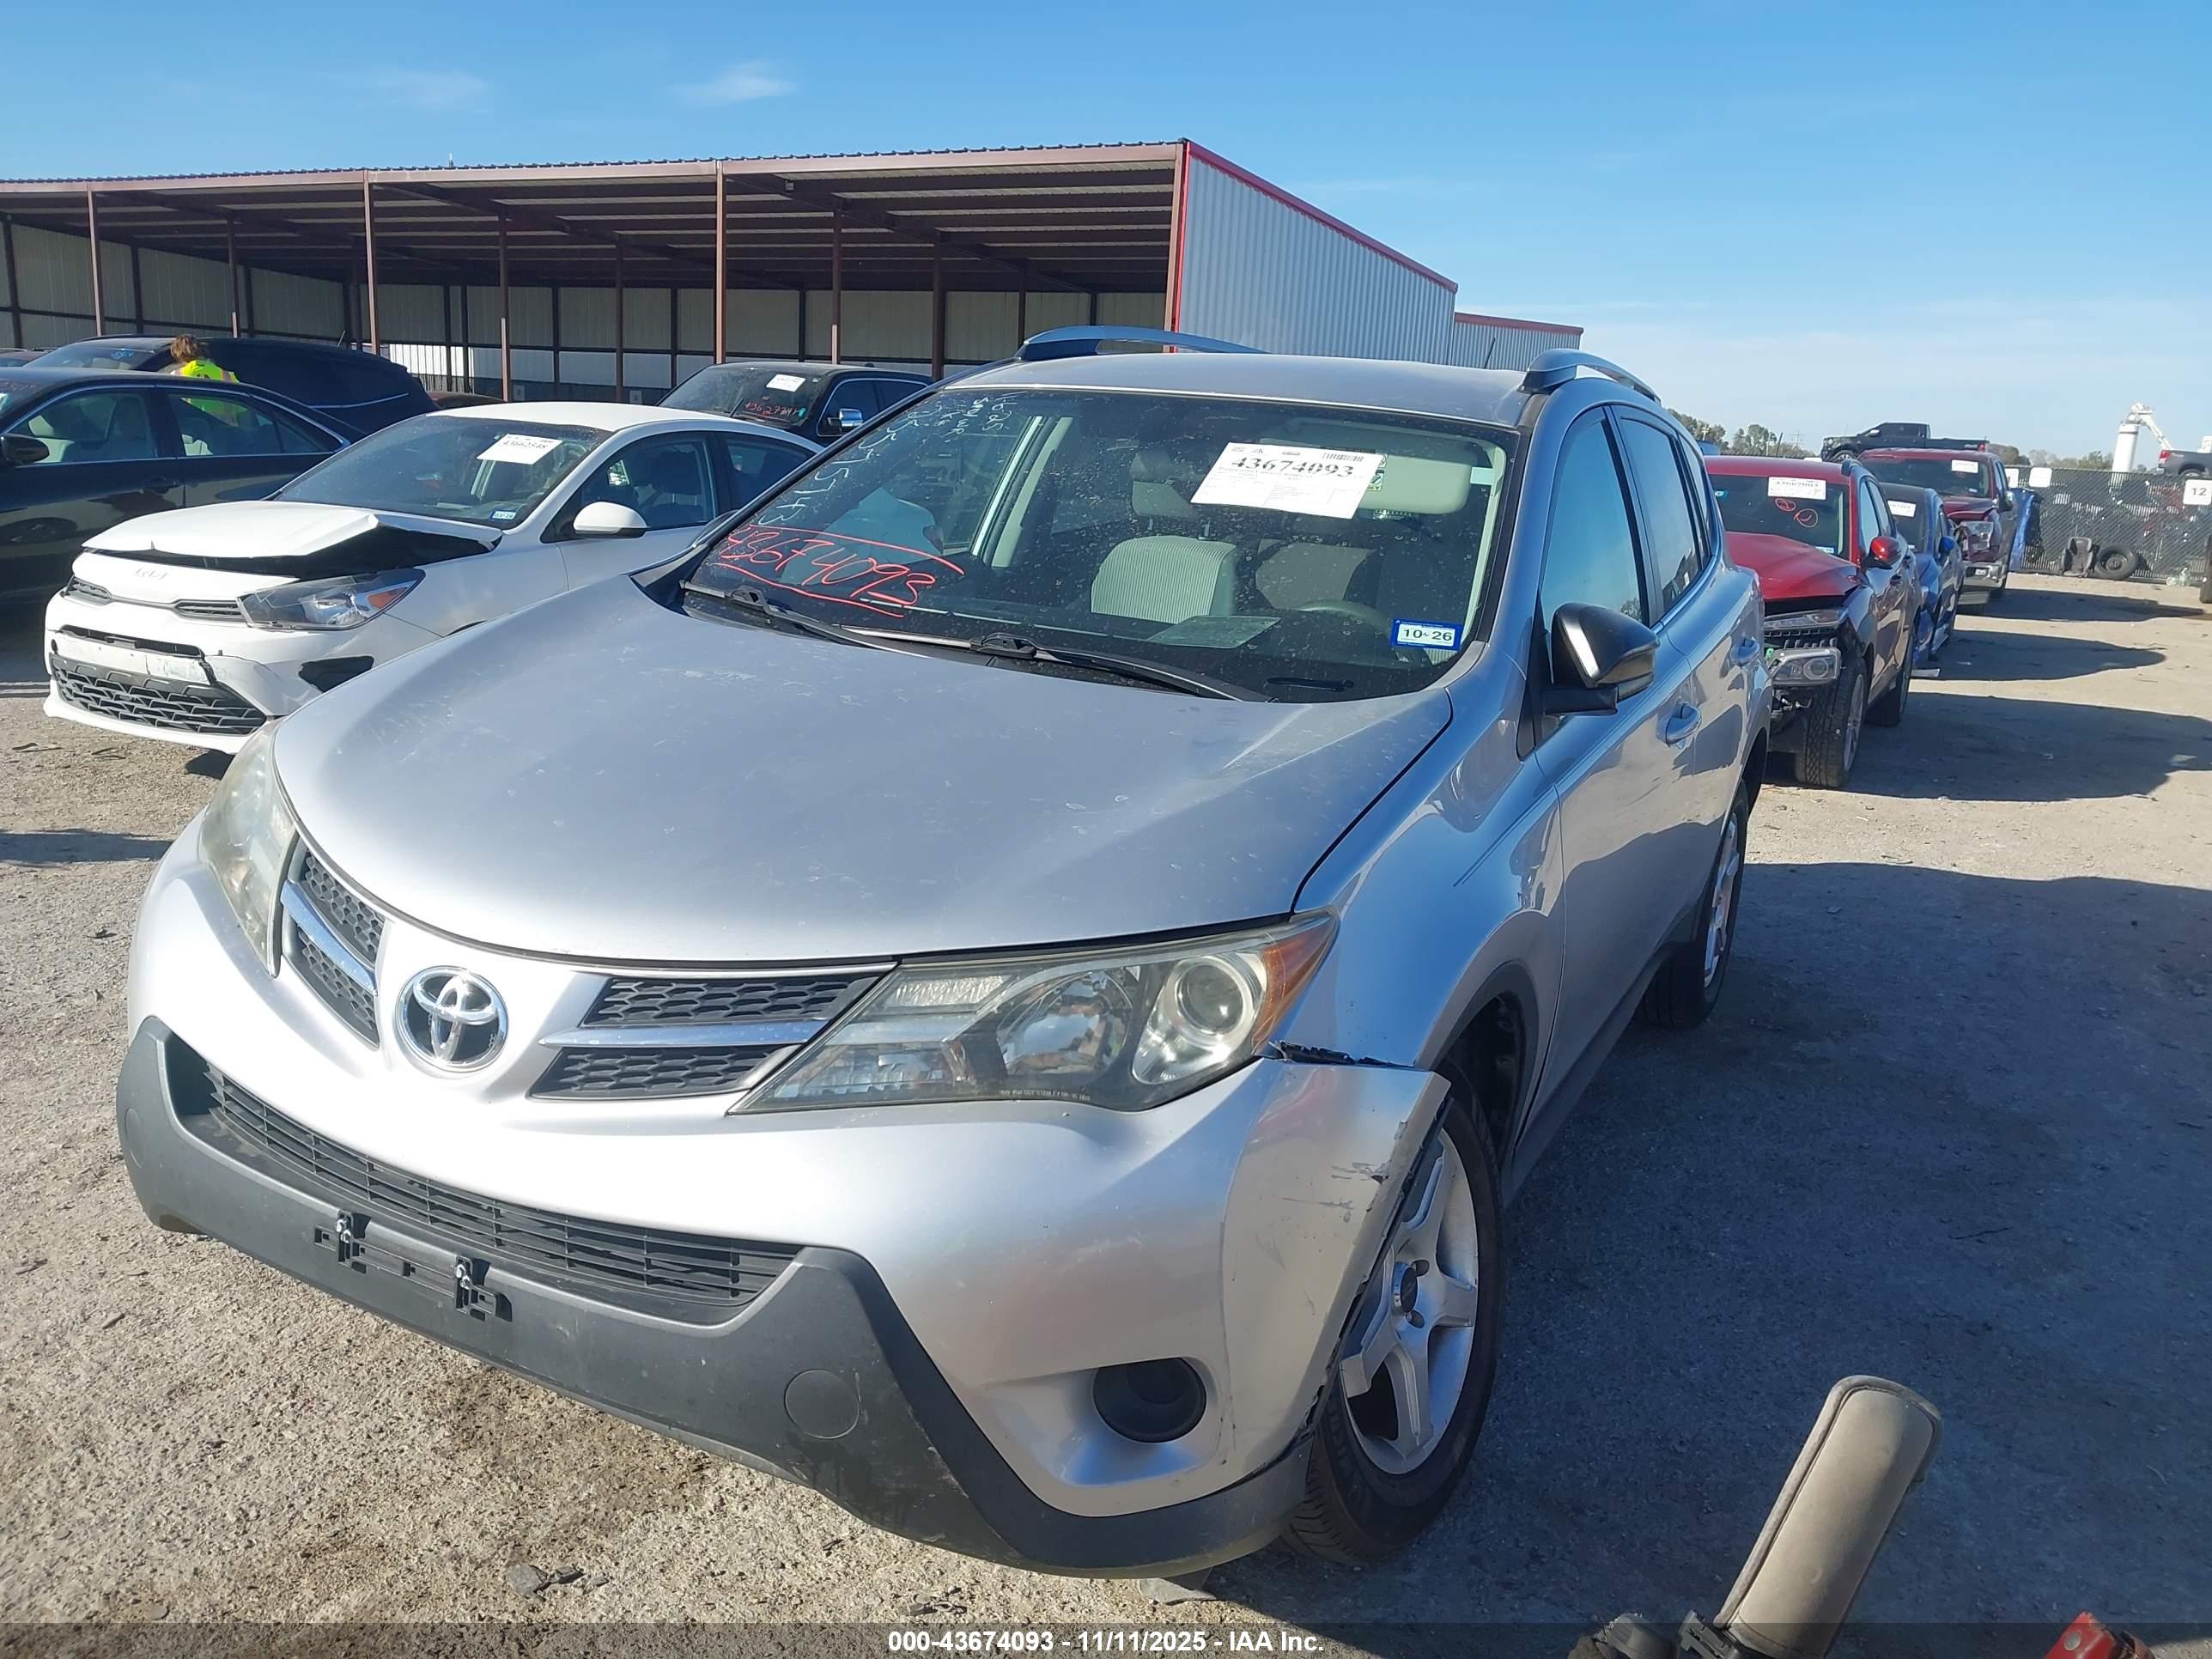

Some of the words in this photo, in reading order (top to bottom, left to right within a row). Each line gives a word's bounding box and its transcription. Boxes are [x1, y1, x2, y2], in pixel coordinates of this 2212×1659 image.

[1231, 456, 1355, 477] 43674093
[2191, 487, 2208, 496] 12
[720, 526, 937, 606] 43674093
